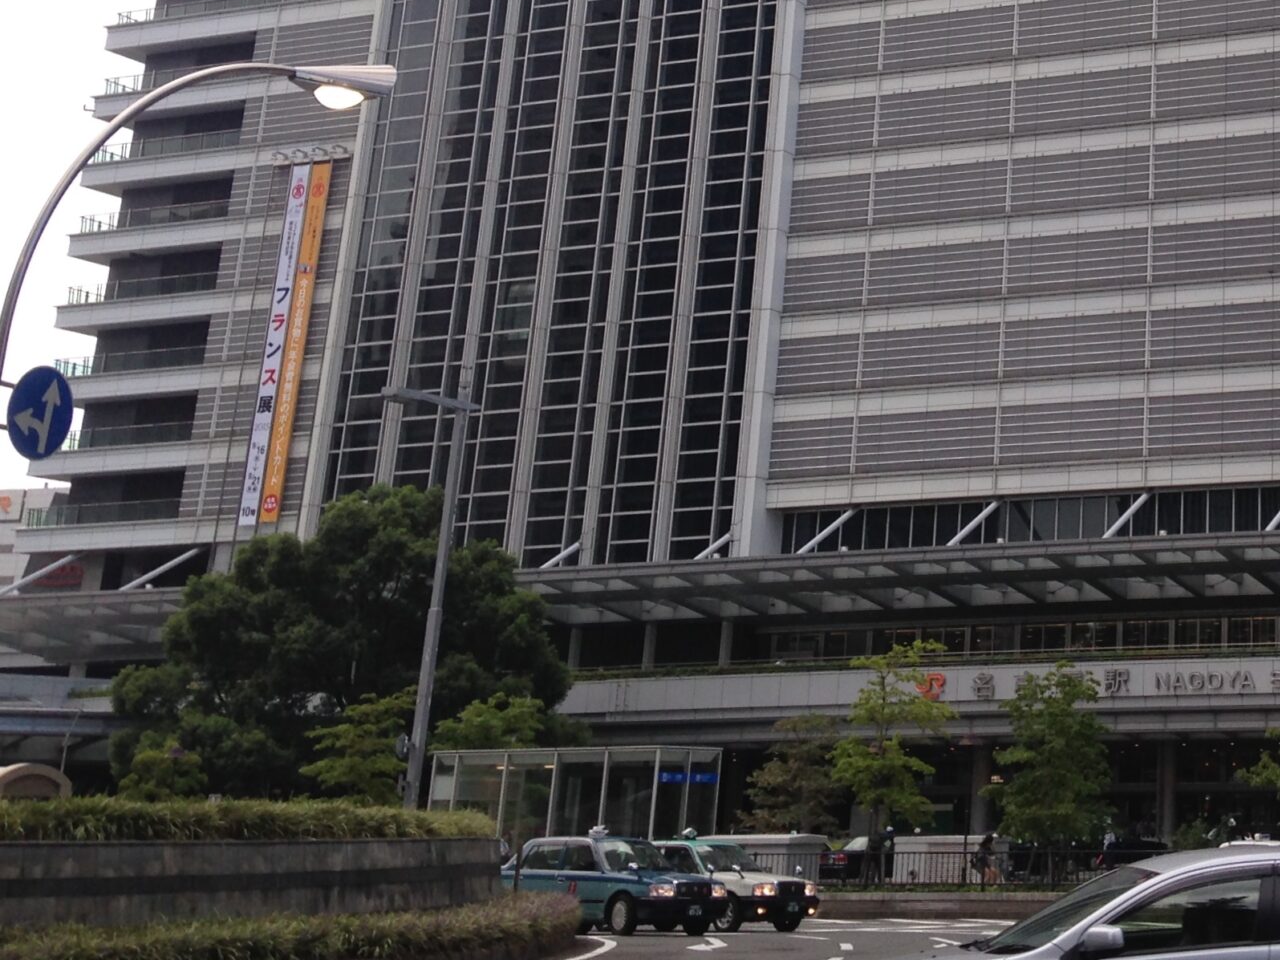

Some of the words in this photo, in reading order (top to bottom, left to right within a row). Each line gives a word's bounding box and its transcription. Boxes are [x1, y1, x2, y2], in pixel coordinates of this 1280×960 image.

[257, 287, 290, 413] フランス展
[1155, 670, 1256, 691] NAGOYA
